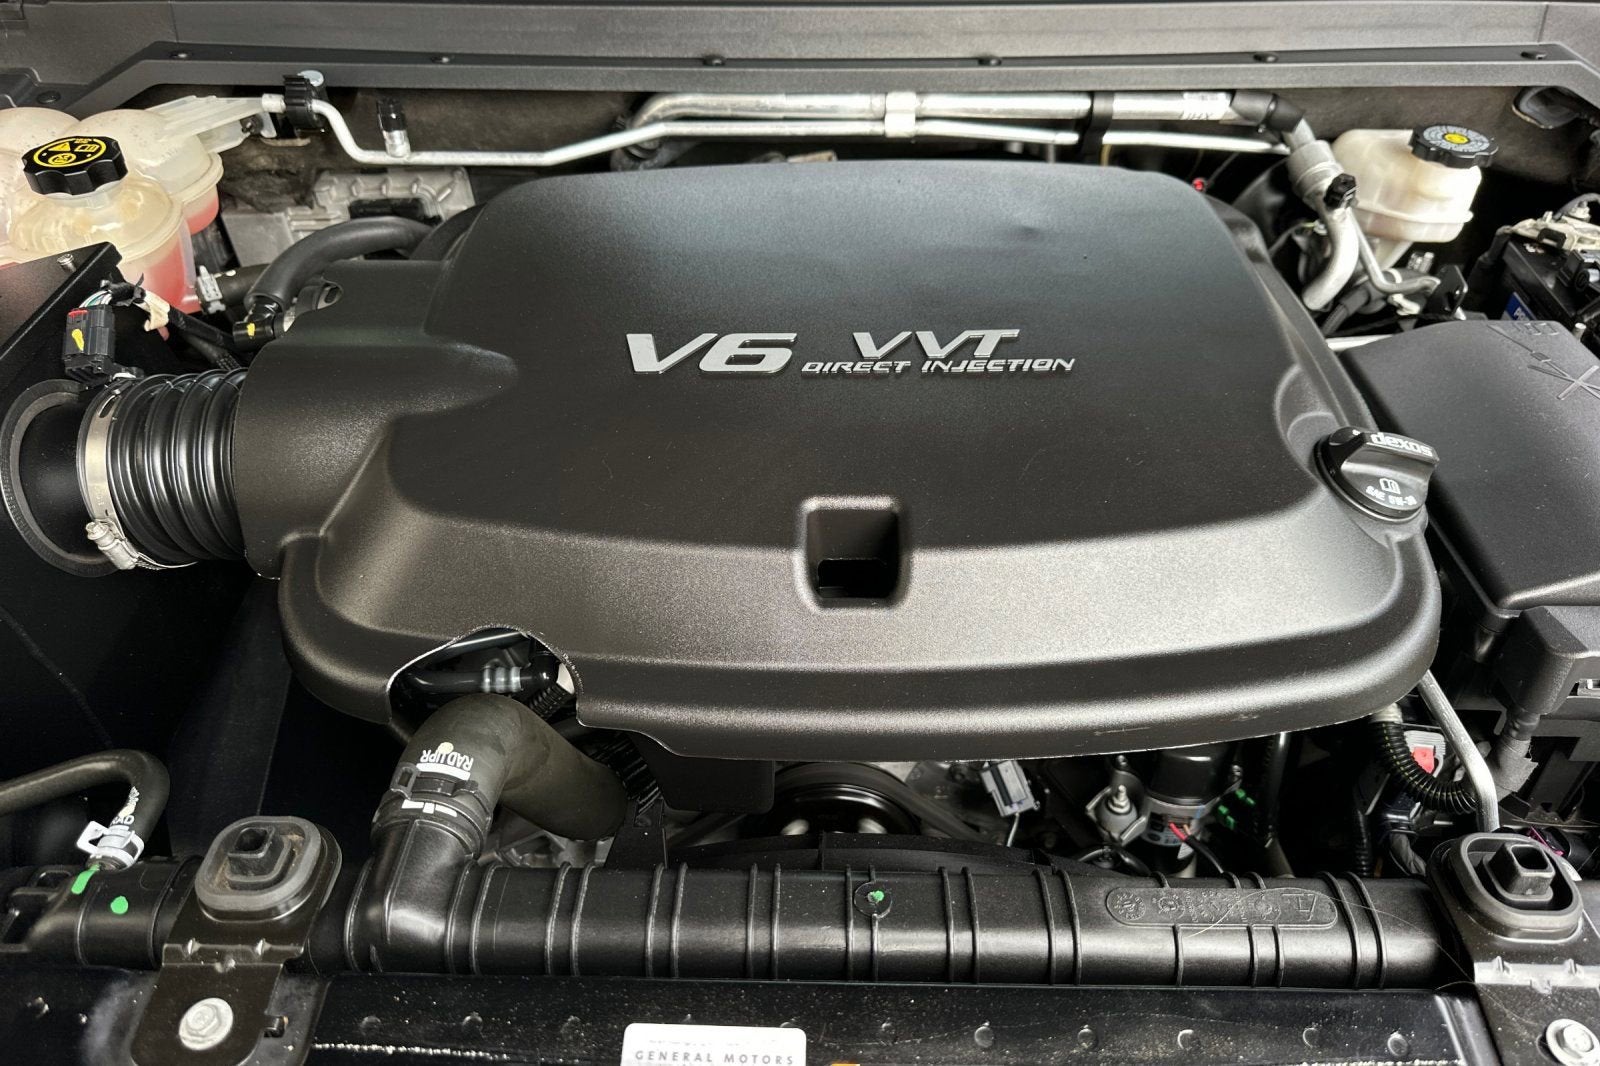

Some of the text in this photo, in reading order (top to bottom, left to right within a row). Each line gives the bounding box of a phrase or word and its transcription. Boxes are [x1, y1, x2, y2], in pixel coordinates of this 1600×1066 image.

[626, 332, 797, 374] V6
[853, 328, 1021, 359] VVT
[801, 357, 1076, 375] DIRECT INJECTION
[446, 751, 473, 771] RAD
[635, 1050, 794, 1066] GENERAL MOTORS
